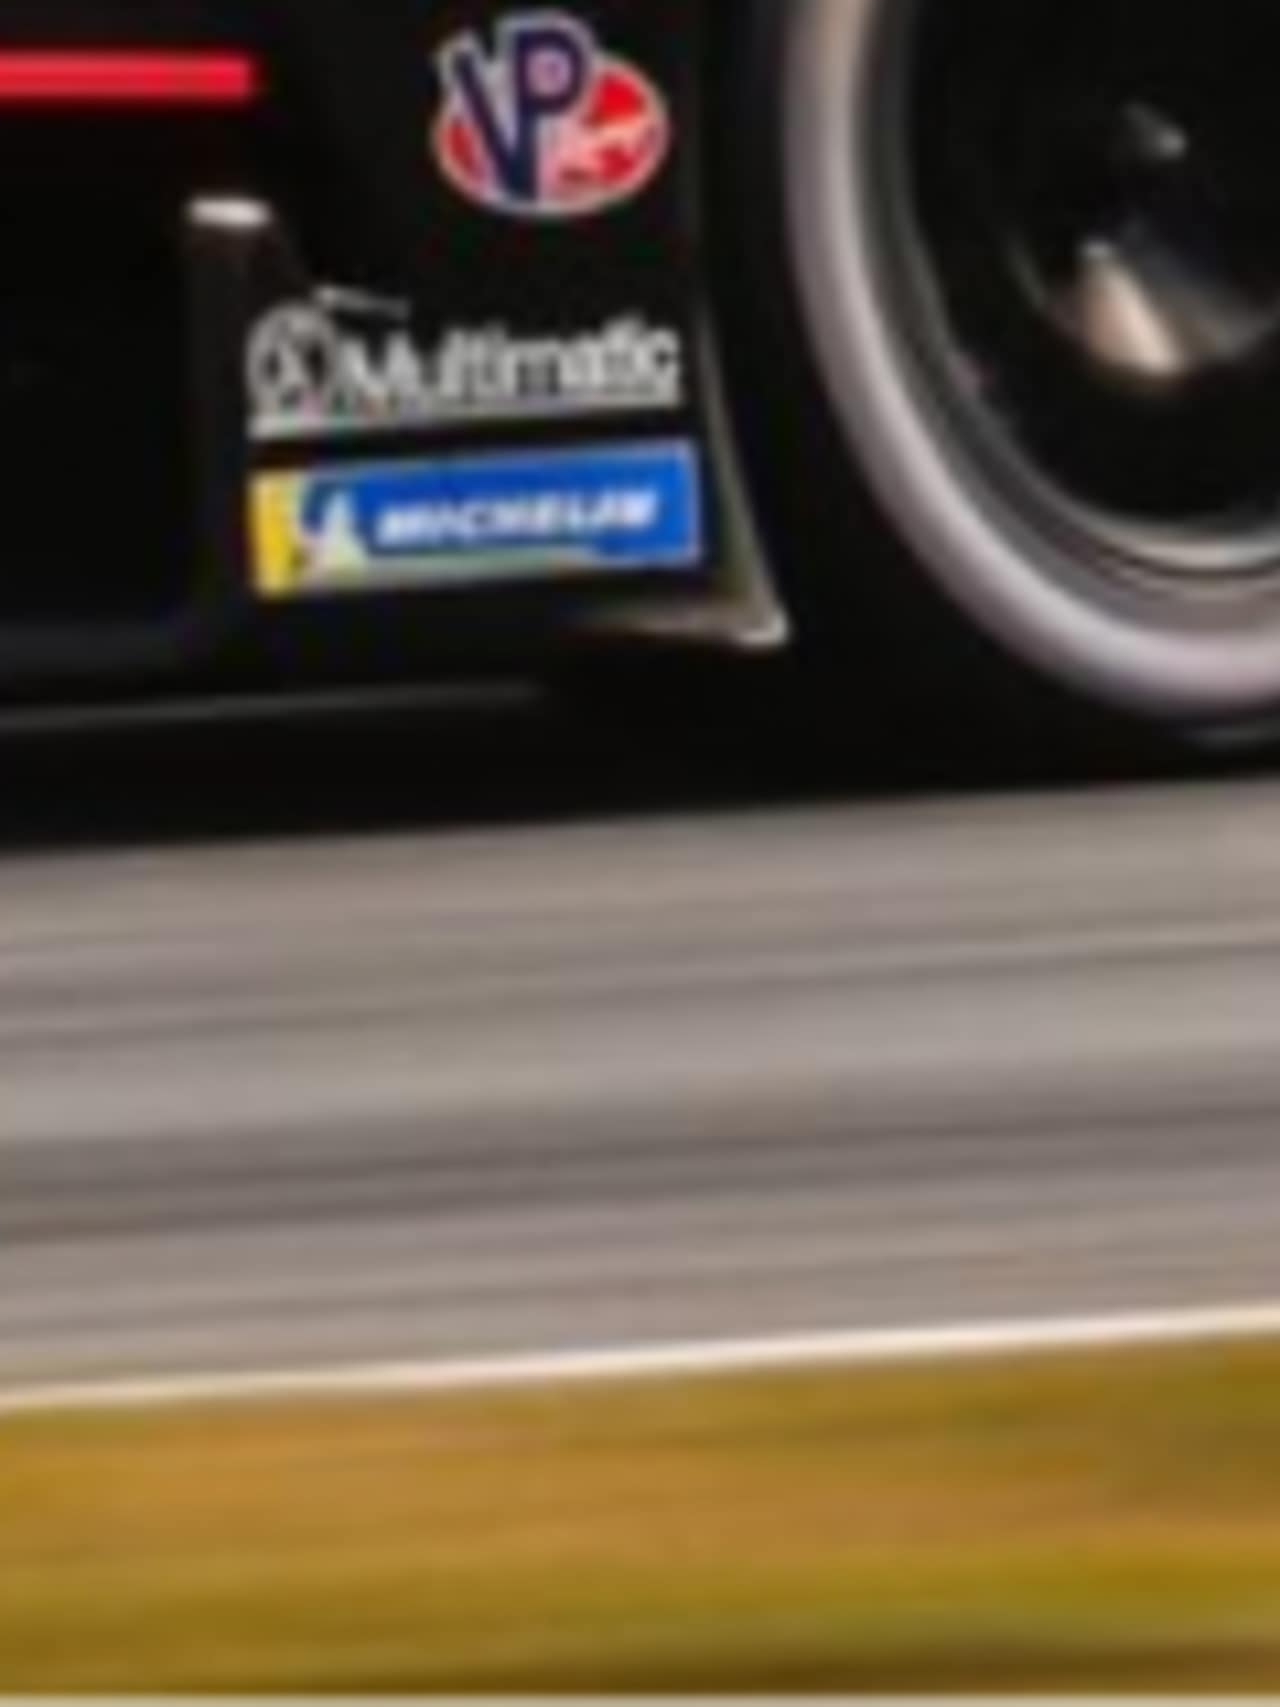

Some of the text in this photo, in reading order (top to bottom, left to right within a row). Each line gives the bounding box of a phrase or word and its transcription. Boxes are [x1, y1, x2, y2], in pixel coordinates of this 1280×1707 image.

[440, 18, 594, 206] VP
[333, 310, 681, 417] Multimatic
[376, 484, 660, 548] MICHELIN
